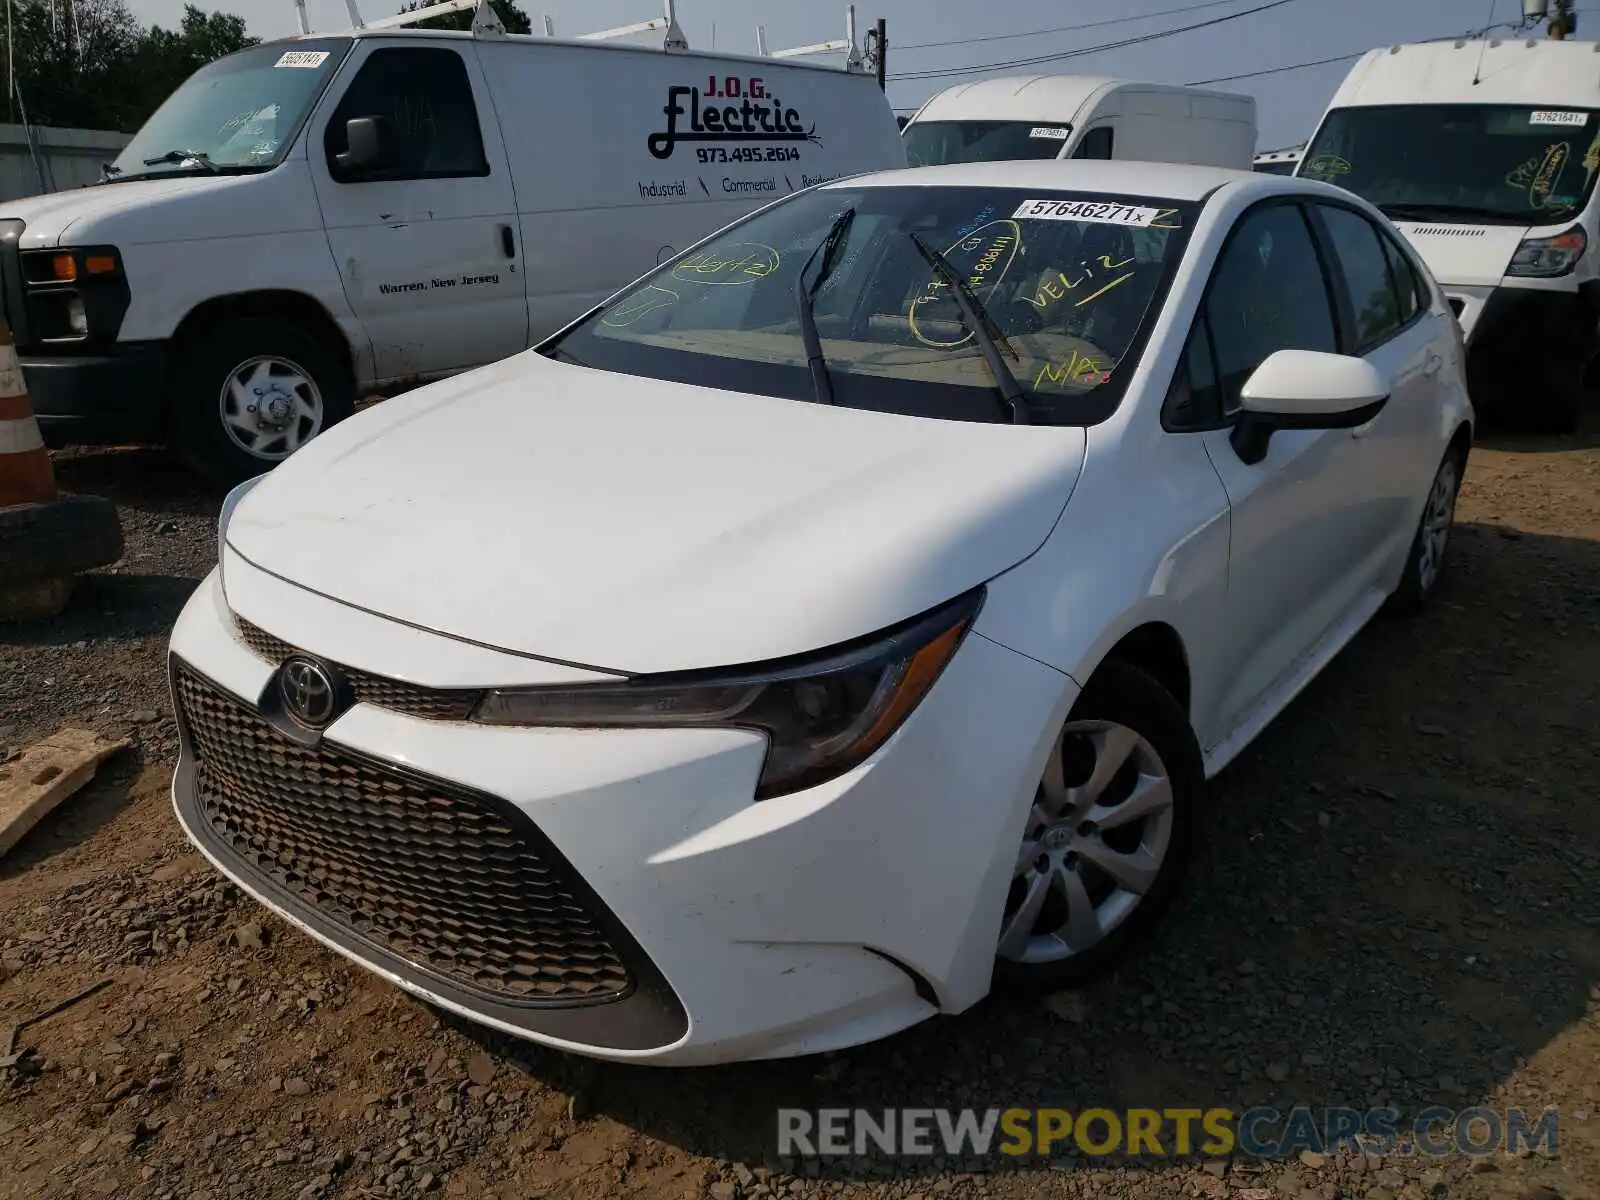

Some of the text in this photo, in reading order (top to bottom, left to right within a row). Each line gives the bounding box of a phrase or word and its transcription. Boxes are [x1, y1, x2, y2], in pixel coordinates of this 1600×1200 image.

[704, 75, 772, 99] J.O.G.
[697, 147, 800, 163] 973.495.2614
[638, 180, 687, 198] Industrial
[722, 177, 776, 192] Commercial
[379, 273, 500, 295] Warren, New Jersey
